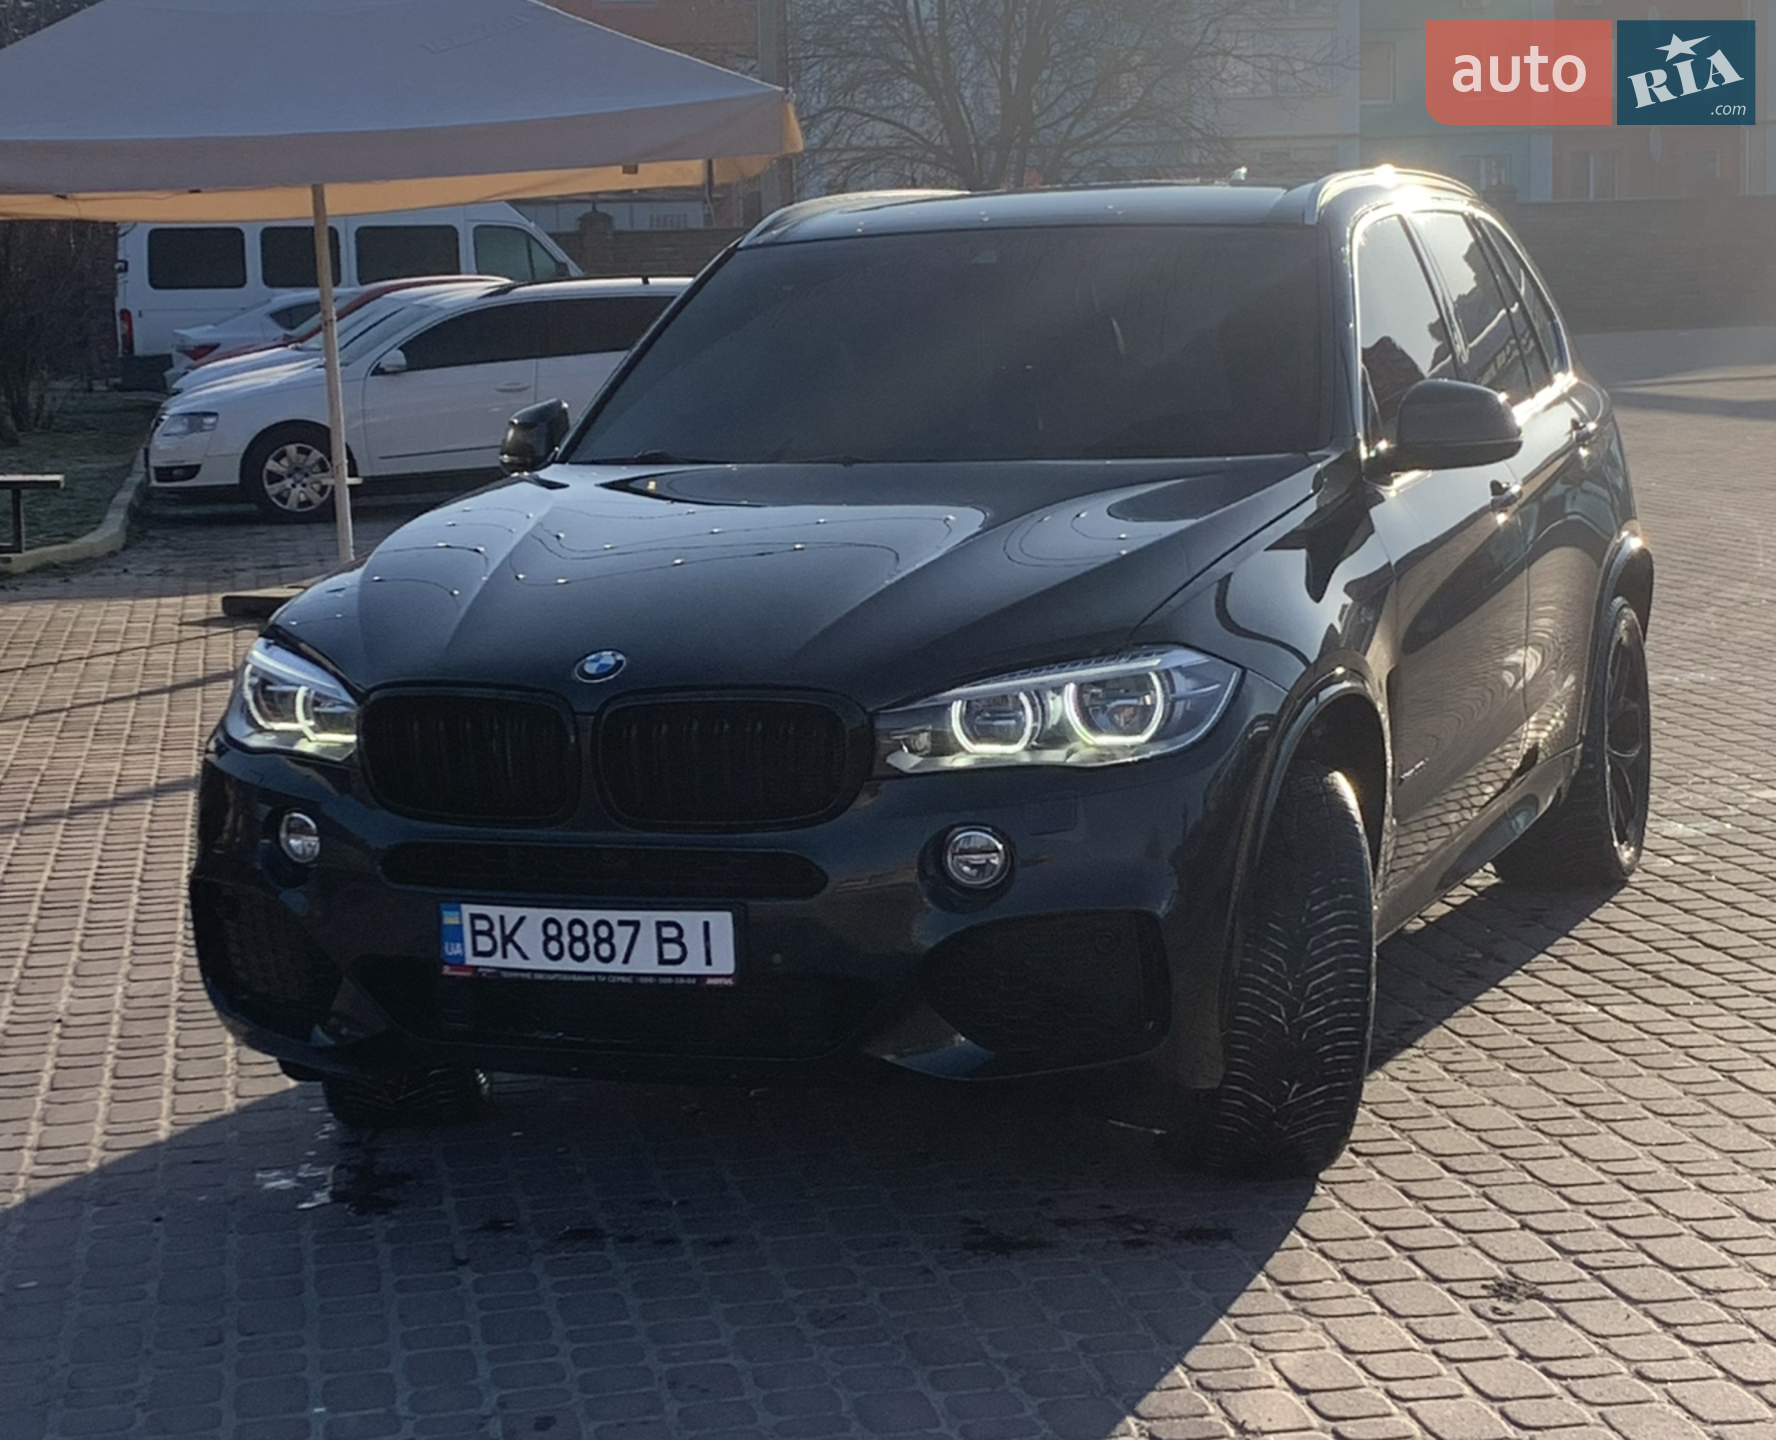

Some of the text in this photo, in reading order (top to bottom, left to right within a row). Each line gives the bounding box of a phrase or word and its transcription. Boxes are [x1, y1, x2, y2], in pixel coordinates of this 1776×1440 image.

[444, 942, 463, 956] UA
[469, 913, 530, 960] BK
[542, 917, 641, 965] 8887
